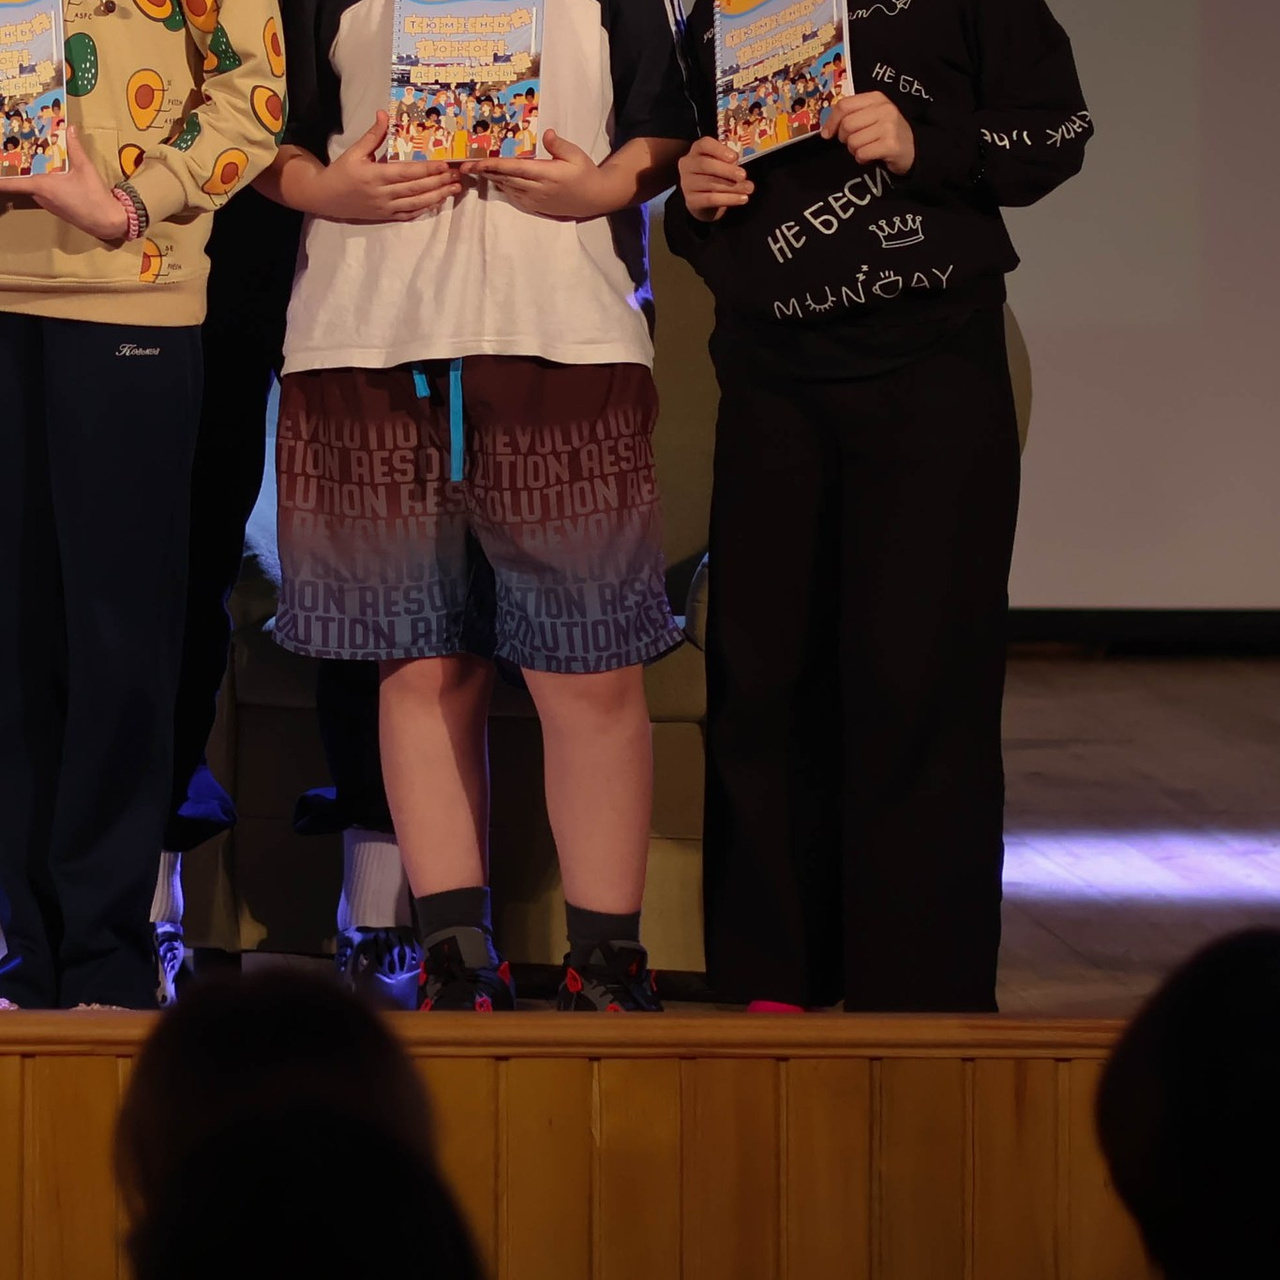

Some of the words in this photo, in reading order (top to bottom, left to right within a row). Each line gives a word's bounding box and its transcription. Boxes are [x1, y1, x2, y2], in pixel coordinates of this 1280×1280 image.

[409, 20, 505, 30] ТЮМЕНЬ
[414, 69, 514, 80] ДРУЖБЫ
[872, 62, 896, 83] НЕ
[767, 221, 807, 264] НЕ
[803, 166, 895, 235] БЕСИ
[350, 449, 441, 484] RESO
